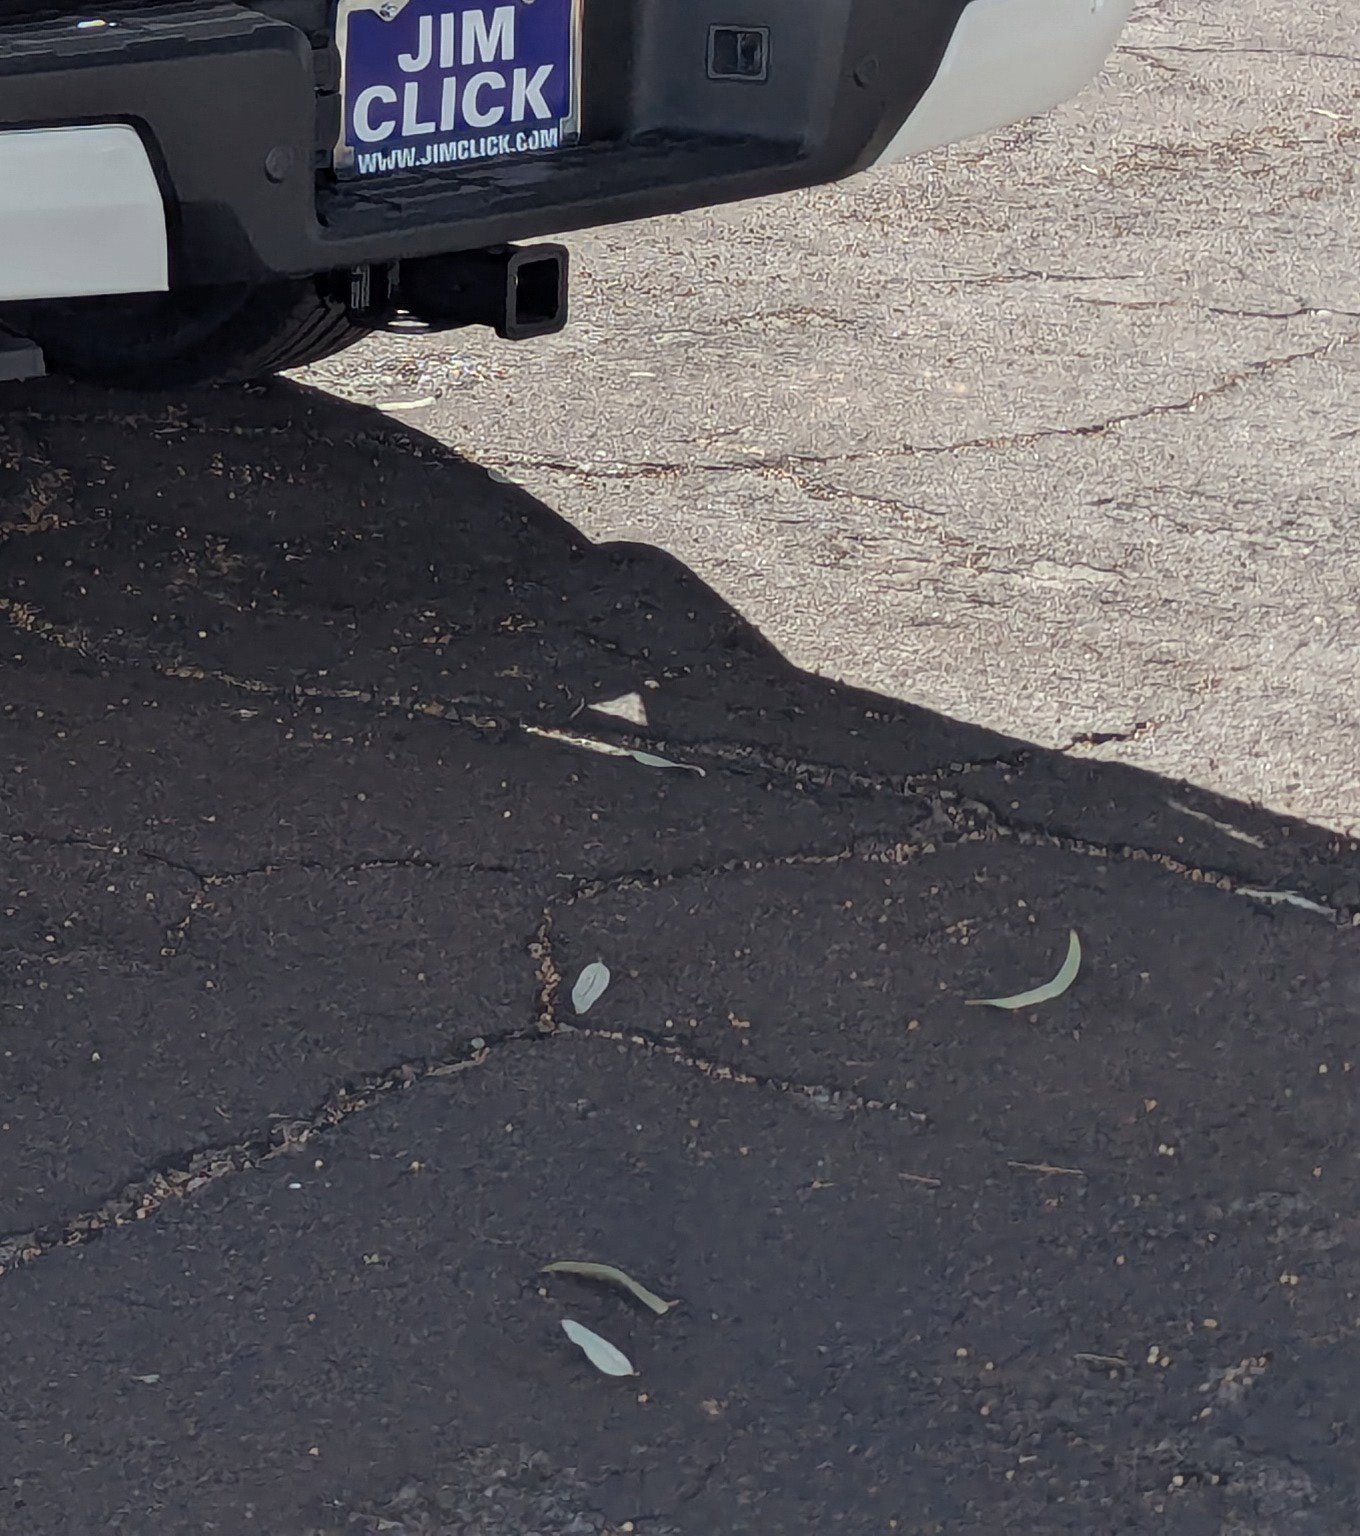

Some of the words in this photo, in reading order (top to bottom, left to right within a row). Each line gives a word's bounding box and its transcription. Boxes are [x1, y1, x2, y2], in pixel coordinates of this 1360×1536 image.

[397, 5, 516, 73] JIM
[352, 64, 555, 144] CLICK
[357, 128, 559, 174] WWW.JIMCLICK.COM
